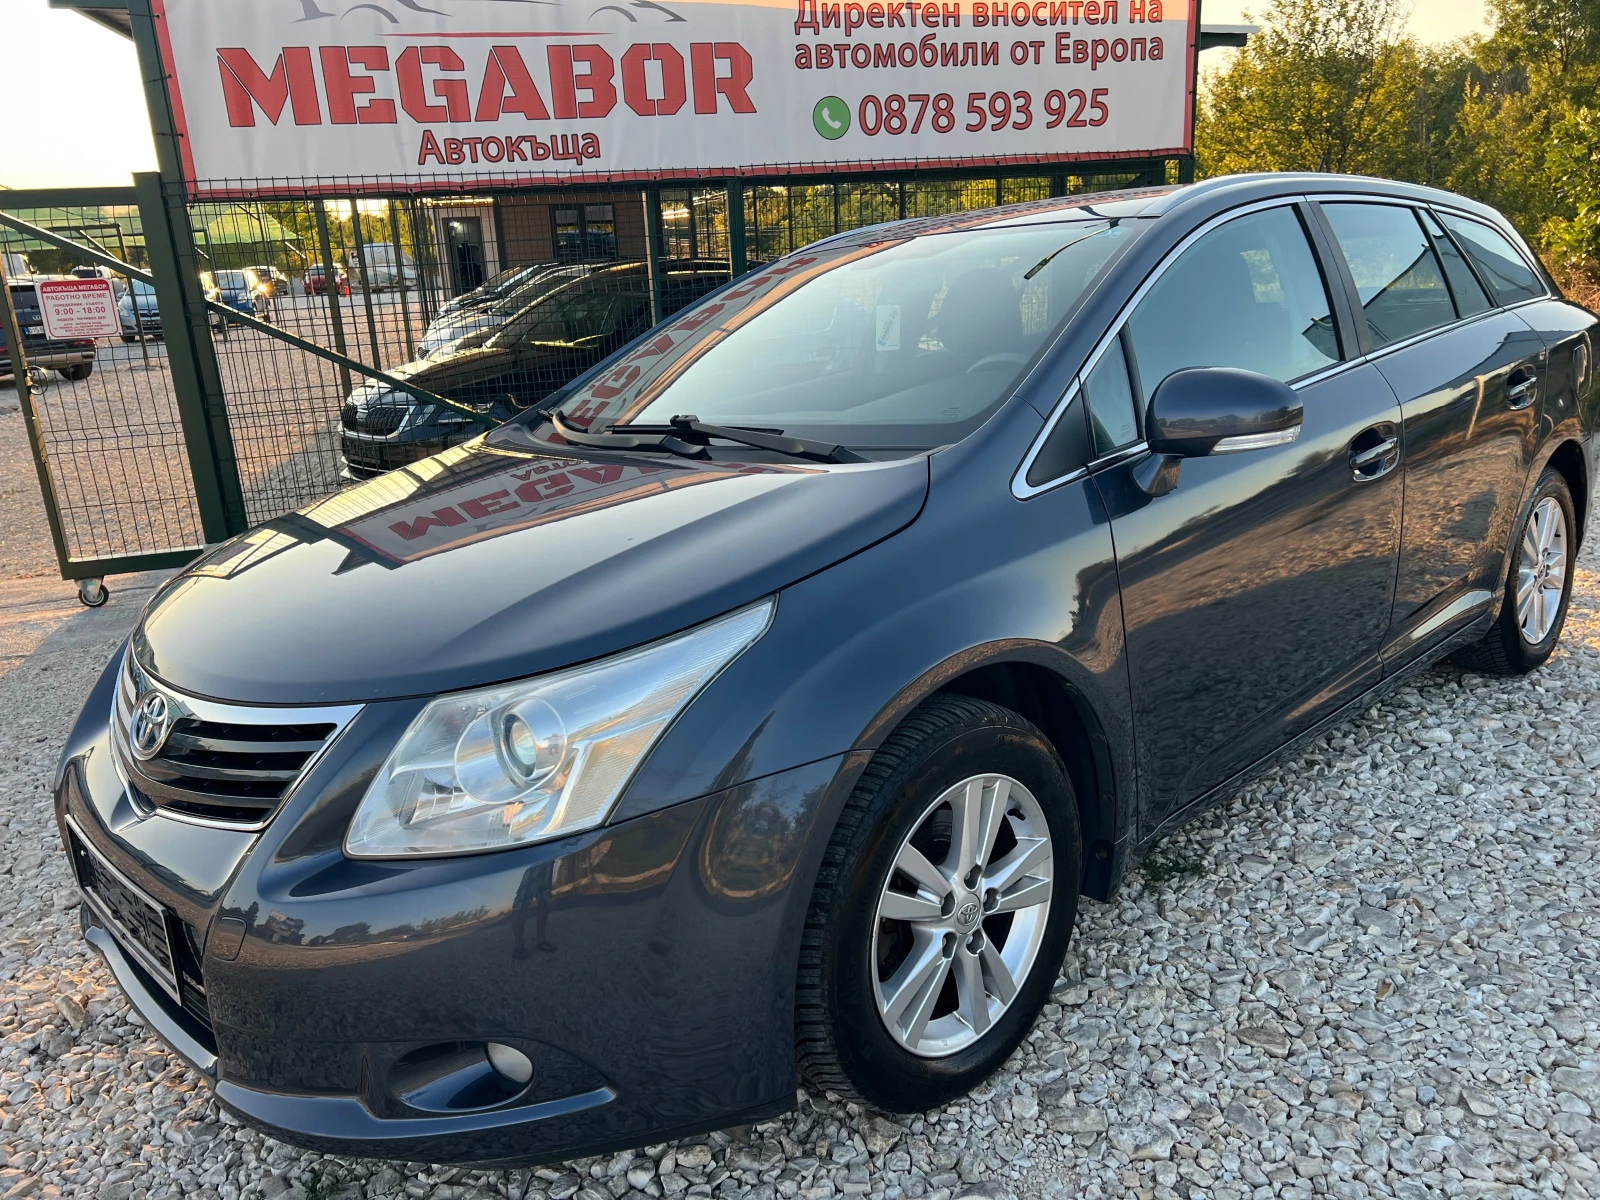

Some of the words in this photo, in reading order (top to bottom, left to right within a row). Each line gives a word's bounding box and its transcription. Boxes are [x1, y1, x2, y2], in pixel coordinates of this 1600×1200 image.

[794, 0, 960, 37] Директен
[973, 1, 1117, 27] вносител
[1130, 0, 1163, 23] на
[795, 33, 999, 69] автомобили
[1010, 41, 1045, 65] от
[1055, 32, 1163, 71] Европа
[216, 42, 757, 127] MEGABOR
[859, 94, 955, 136] 0878
[966, 90, 1033, 132] 593
[1044, 88, 1109, 129] 925
[418, 130, 600, 165] Автокъща
[54, 307, 74, 315] 9:00
[82, 306, 106, 314] 18:00
